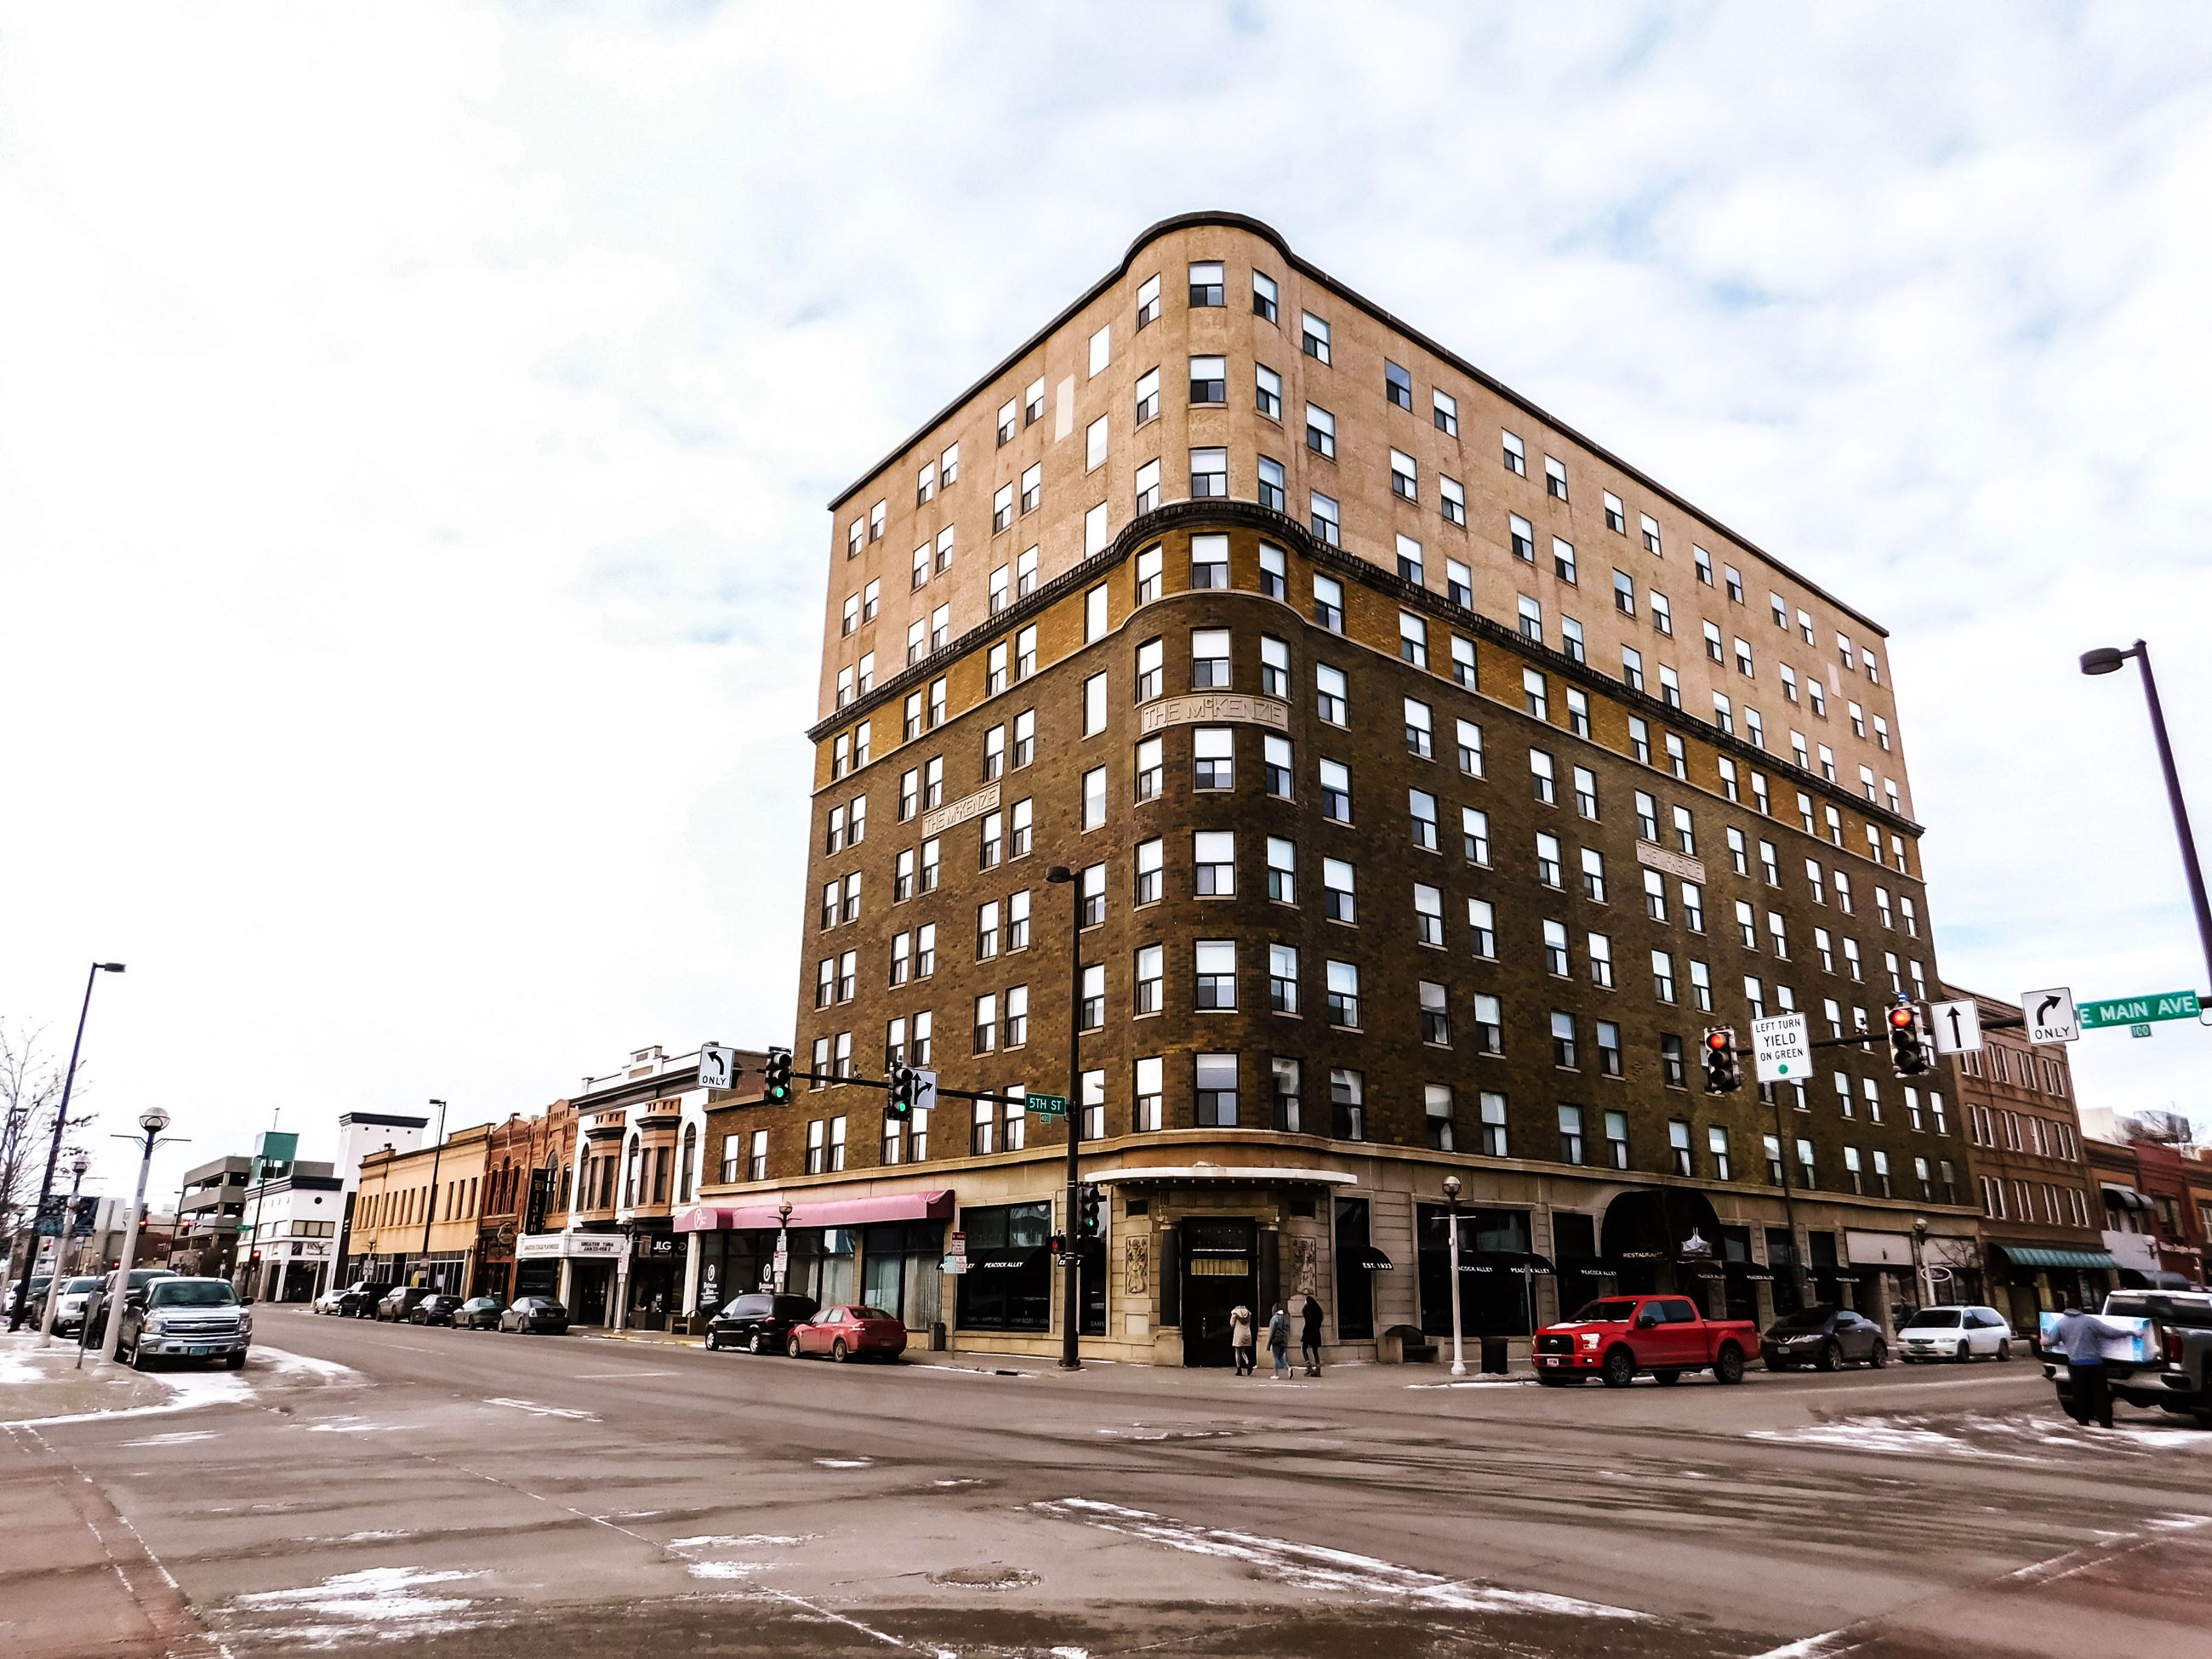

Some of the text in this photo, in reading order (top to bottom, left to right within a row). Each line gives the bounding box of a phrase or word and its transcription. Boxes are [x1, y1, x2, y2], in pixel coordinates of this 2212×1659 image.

[1144, 702, 1180, 728] THE
[925, 811, 945, 835] THE
[2079, 995, 2197, 1023] E MAIN AVE
[1755, 1018, 1801, 1033] LEFT TURN
[1764, 1032, 1796, 1047] YIELD
[2034, 1026, 2071, 1040] ONLY
[1760, 1048, 1804, 1062] ON GREEN
[702, 1075, 727, 1086] ONLY
[1029, 1097, 1062, 1111] 5TH ST
[653, 1241, 672, 1251] JLG
